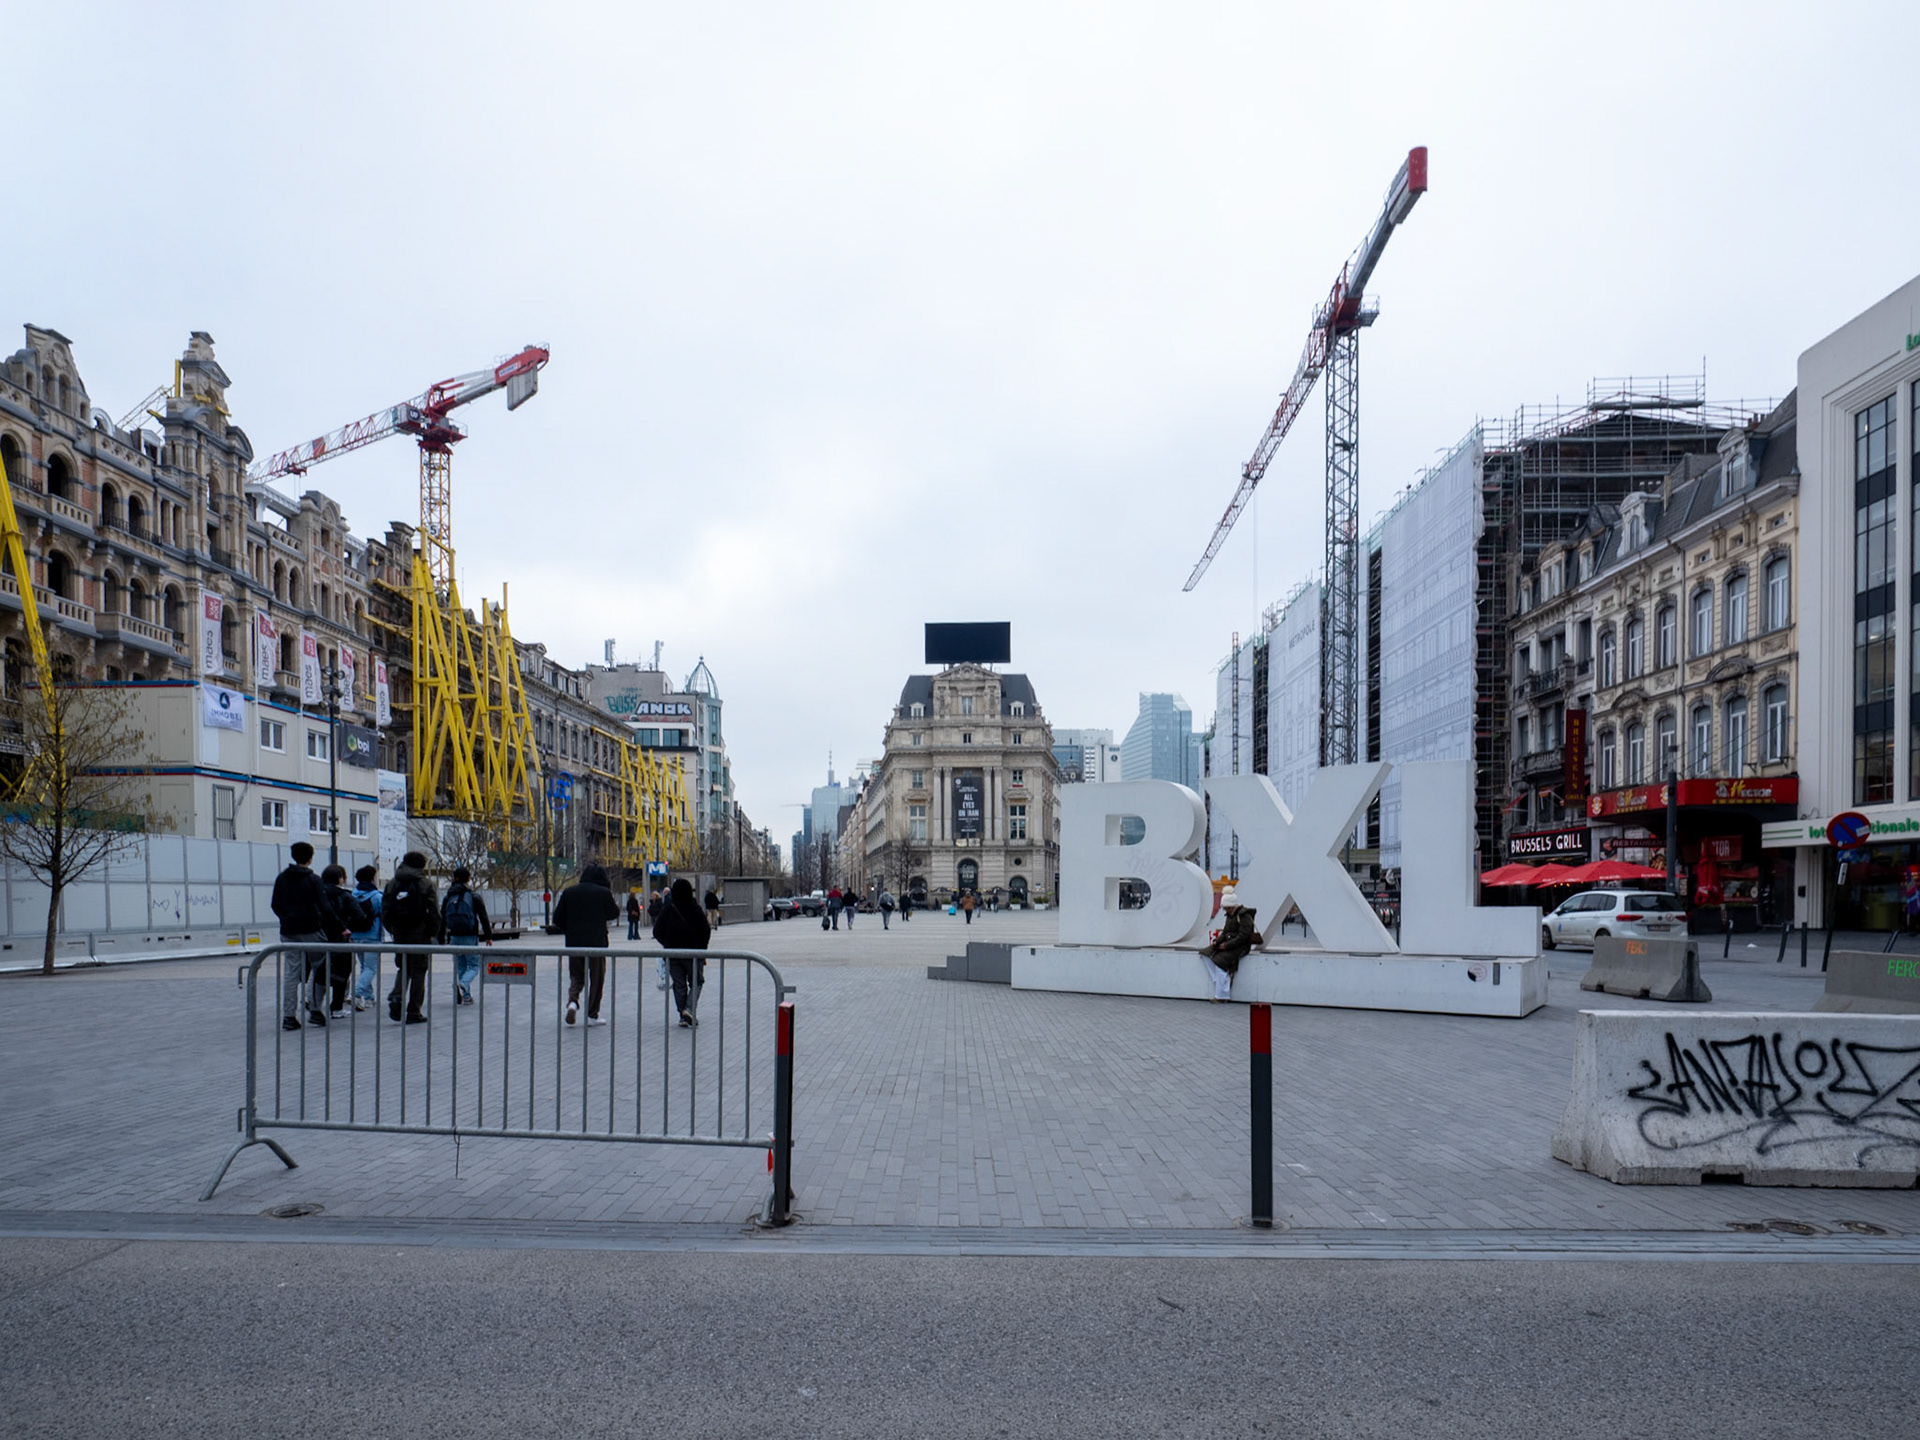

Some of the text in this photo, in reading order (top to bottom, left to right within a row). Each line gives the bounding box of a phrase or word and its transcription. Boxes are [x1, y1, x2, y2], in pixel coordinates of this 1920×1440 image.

[262, 644, 270, 680] maes
[635, 701, 692, 716] ANOK
[357, 737, 370, 753] bpi
[962, 801, 975, 809] EYES
[964, 793, 973, 801] ALL
[1511, 832, 1582, 854] BRUSSELS GRILL
[1059, 759, 1543, 958] BXL
